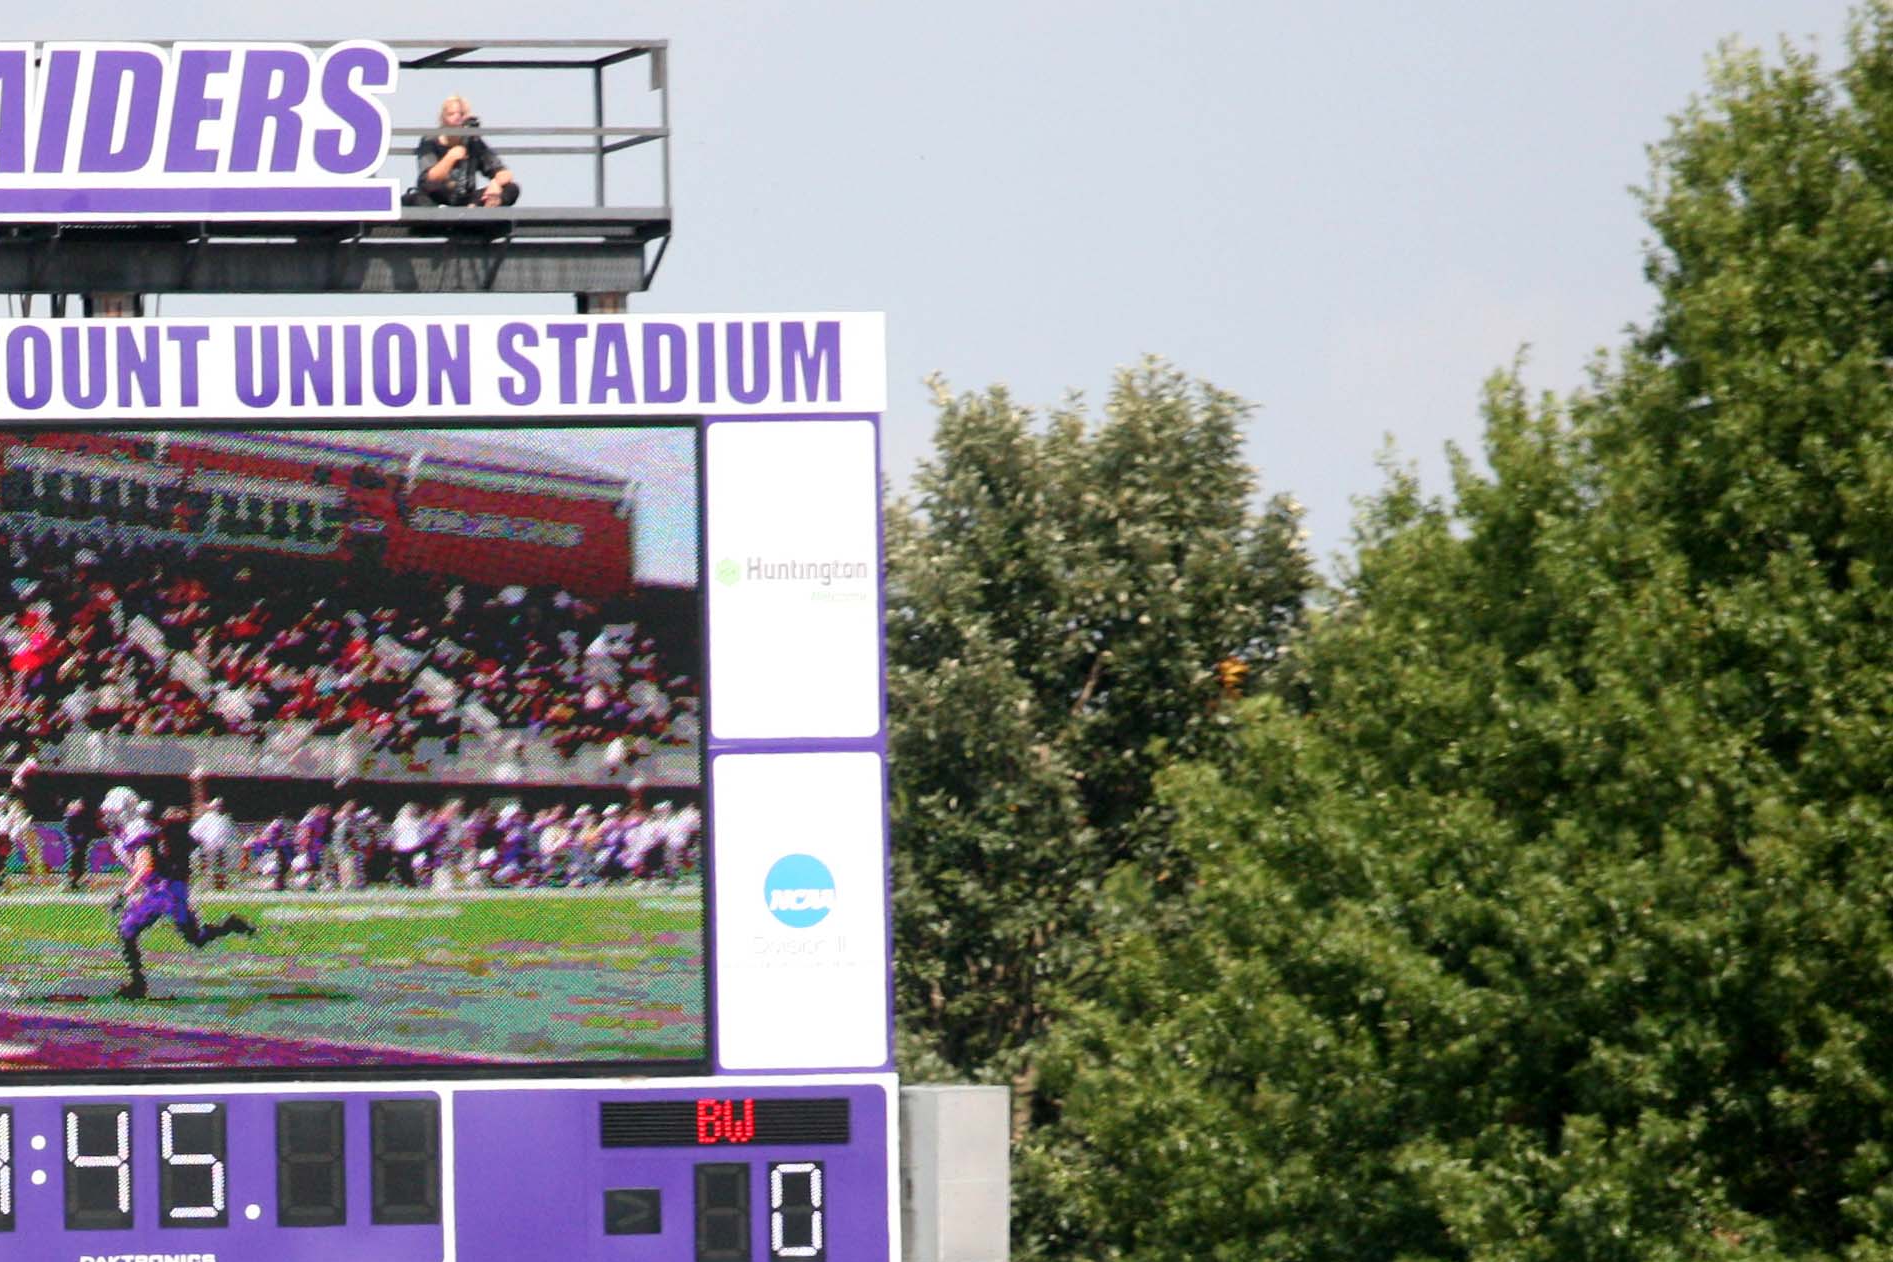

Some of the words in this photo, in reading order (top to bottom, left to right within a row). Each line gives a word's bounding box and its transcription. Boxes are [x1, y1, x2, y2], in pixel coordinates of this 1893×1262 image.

[234, 323, 471, 409] UNION
[497, 321, 841, 406] STADIUM
[746, 557, 868, 586] Huntington
[696, 1097, 756, 1145] BW
[771, 1162, 823, 1257] 0
